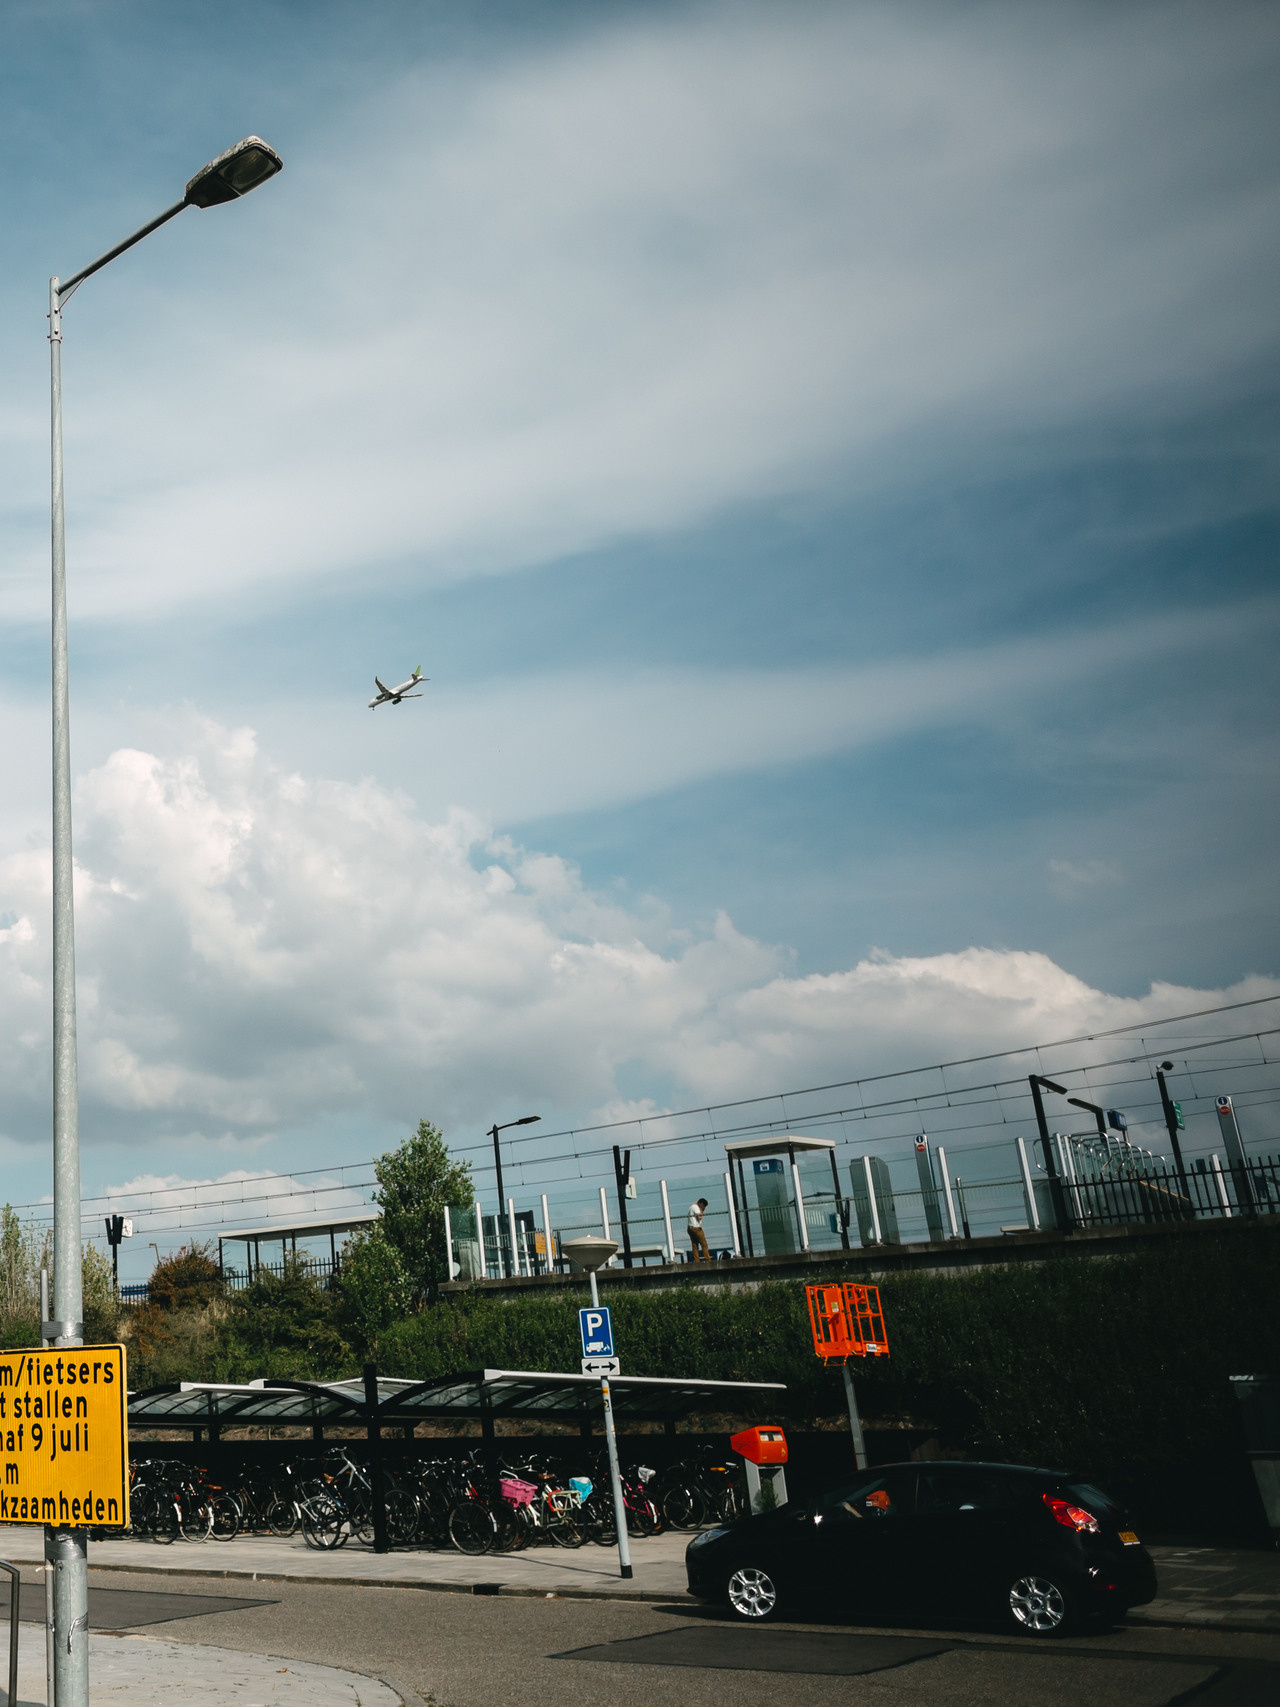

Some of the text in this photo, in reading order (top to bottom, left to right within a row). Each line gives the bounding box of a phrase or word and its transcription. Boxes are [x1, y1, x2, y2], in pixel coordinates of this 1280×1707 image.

[586, 1313, 603, 1337] P
[14, 1390, 88, 1418] stallen
[31, 1423, 43, 1451] 9
[50, 1423, 89, 1461] juli
